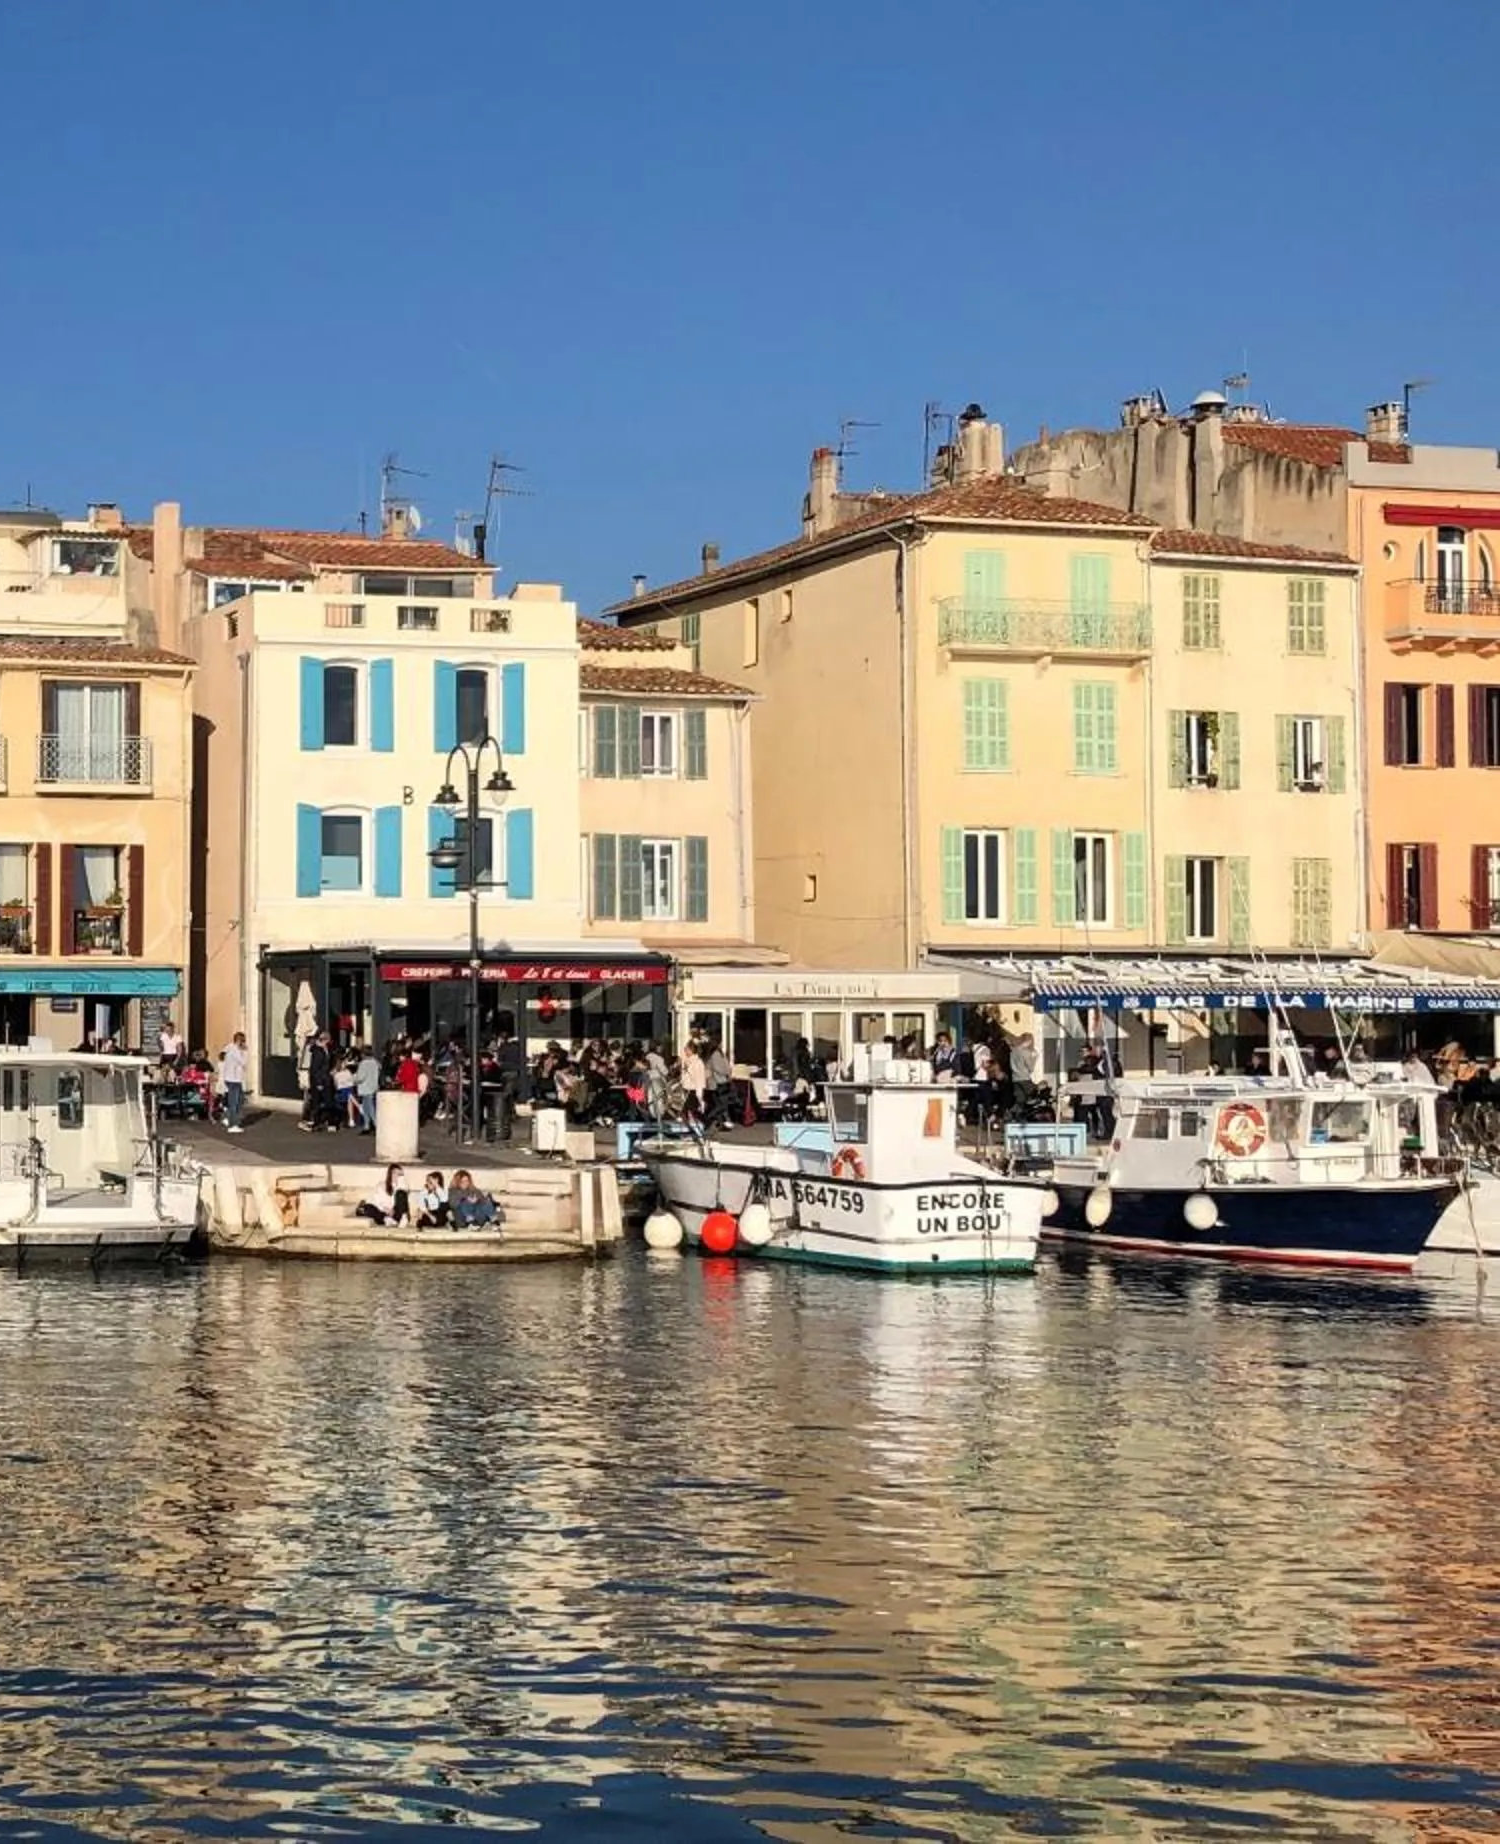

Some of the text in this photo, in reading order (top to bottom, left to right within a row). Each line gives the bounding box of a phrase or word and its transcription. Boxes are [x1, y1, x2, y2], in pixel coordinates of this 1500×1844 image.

[600, 968, 645, 979] GLACIER
[1155, 996, 1205, 1008] BAR
[1223, 995, 1257, 1007] DE
[1274, 996, 1305, 1008] LA
[1325, 996, 1415, 1010] MARINE
[916, 1192, 1006, 1212] ENCORE
[917, 1217, 949, 1233] UN
